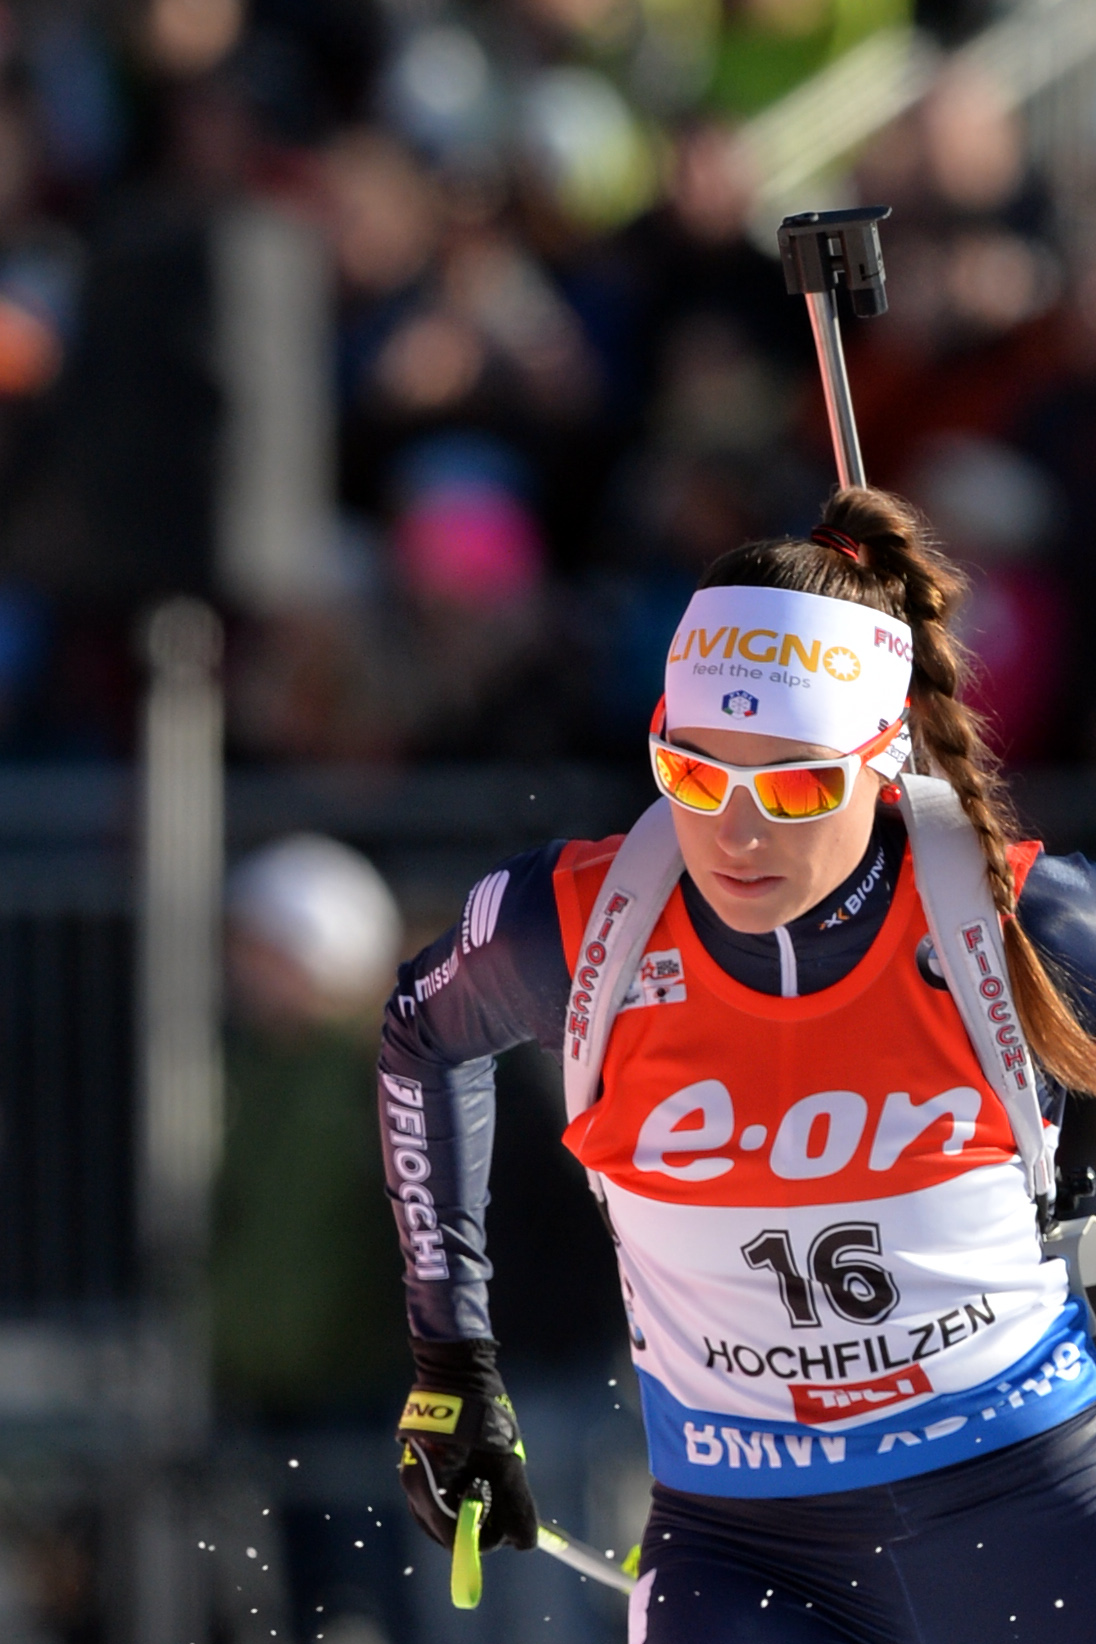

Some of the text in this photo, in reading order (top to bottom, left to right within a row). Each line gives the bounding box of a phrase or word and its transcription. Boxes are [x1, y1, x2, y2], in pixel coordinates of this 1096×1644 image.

[668, 627, 861, 682] LIVIGNO
[692, 662, 811, 690] feel the alps
[572, 892, 630, 1060] FIOCCHI
[960, 924, 1027, 1091] FIOCCHI
[741, 1220, 901, 1329] 16
[703, 1293, 997, 1381] HOCHFILZEN
[683, 1421, 847, 1470] BMW
